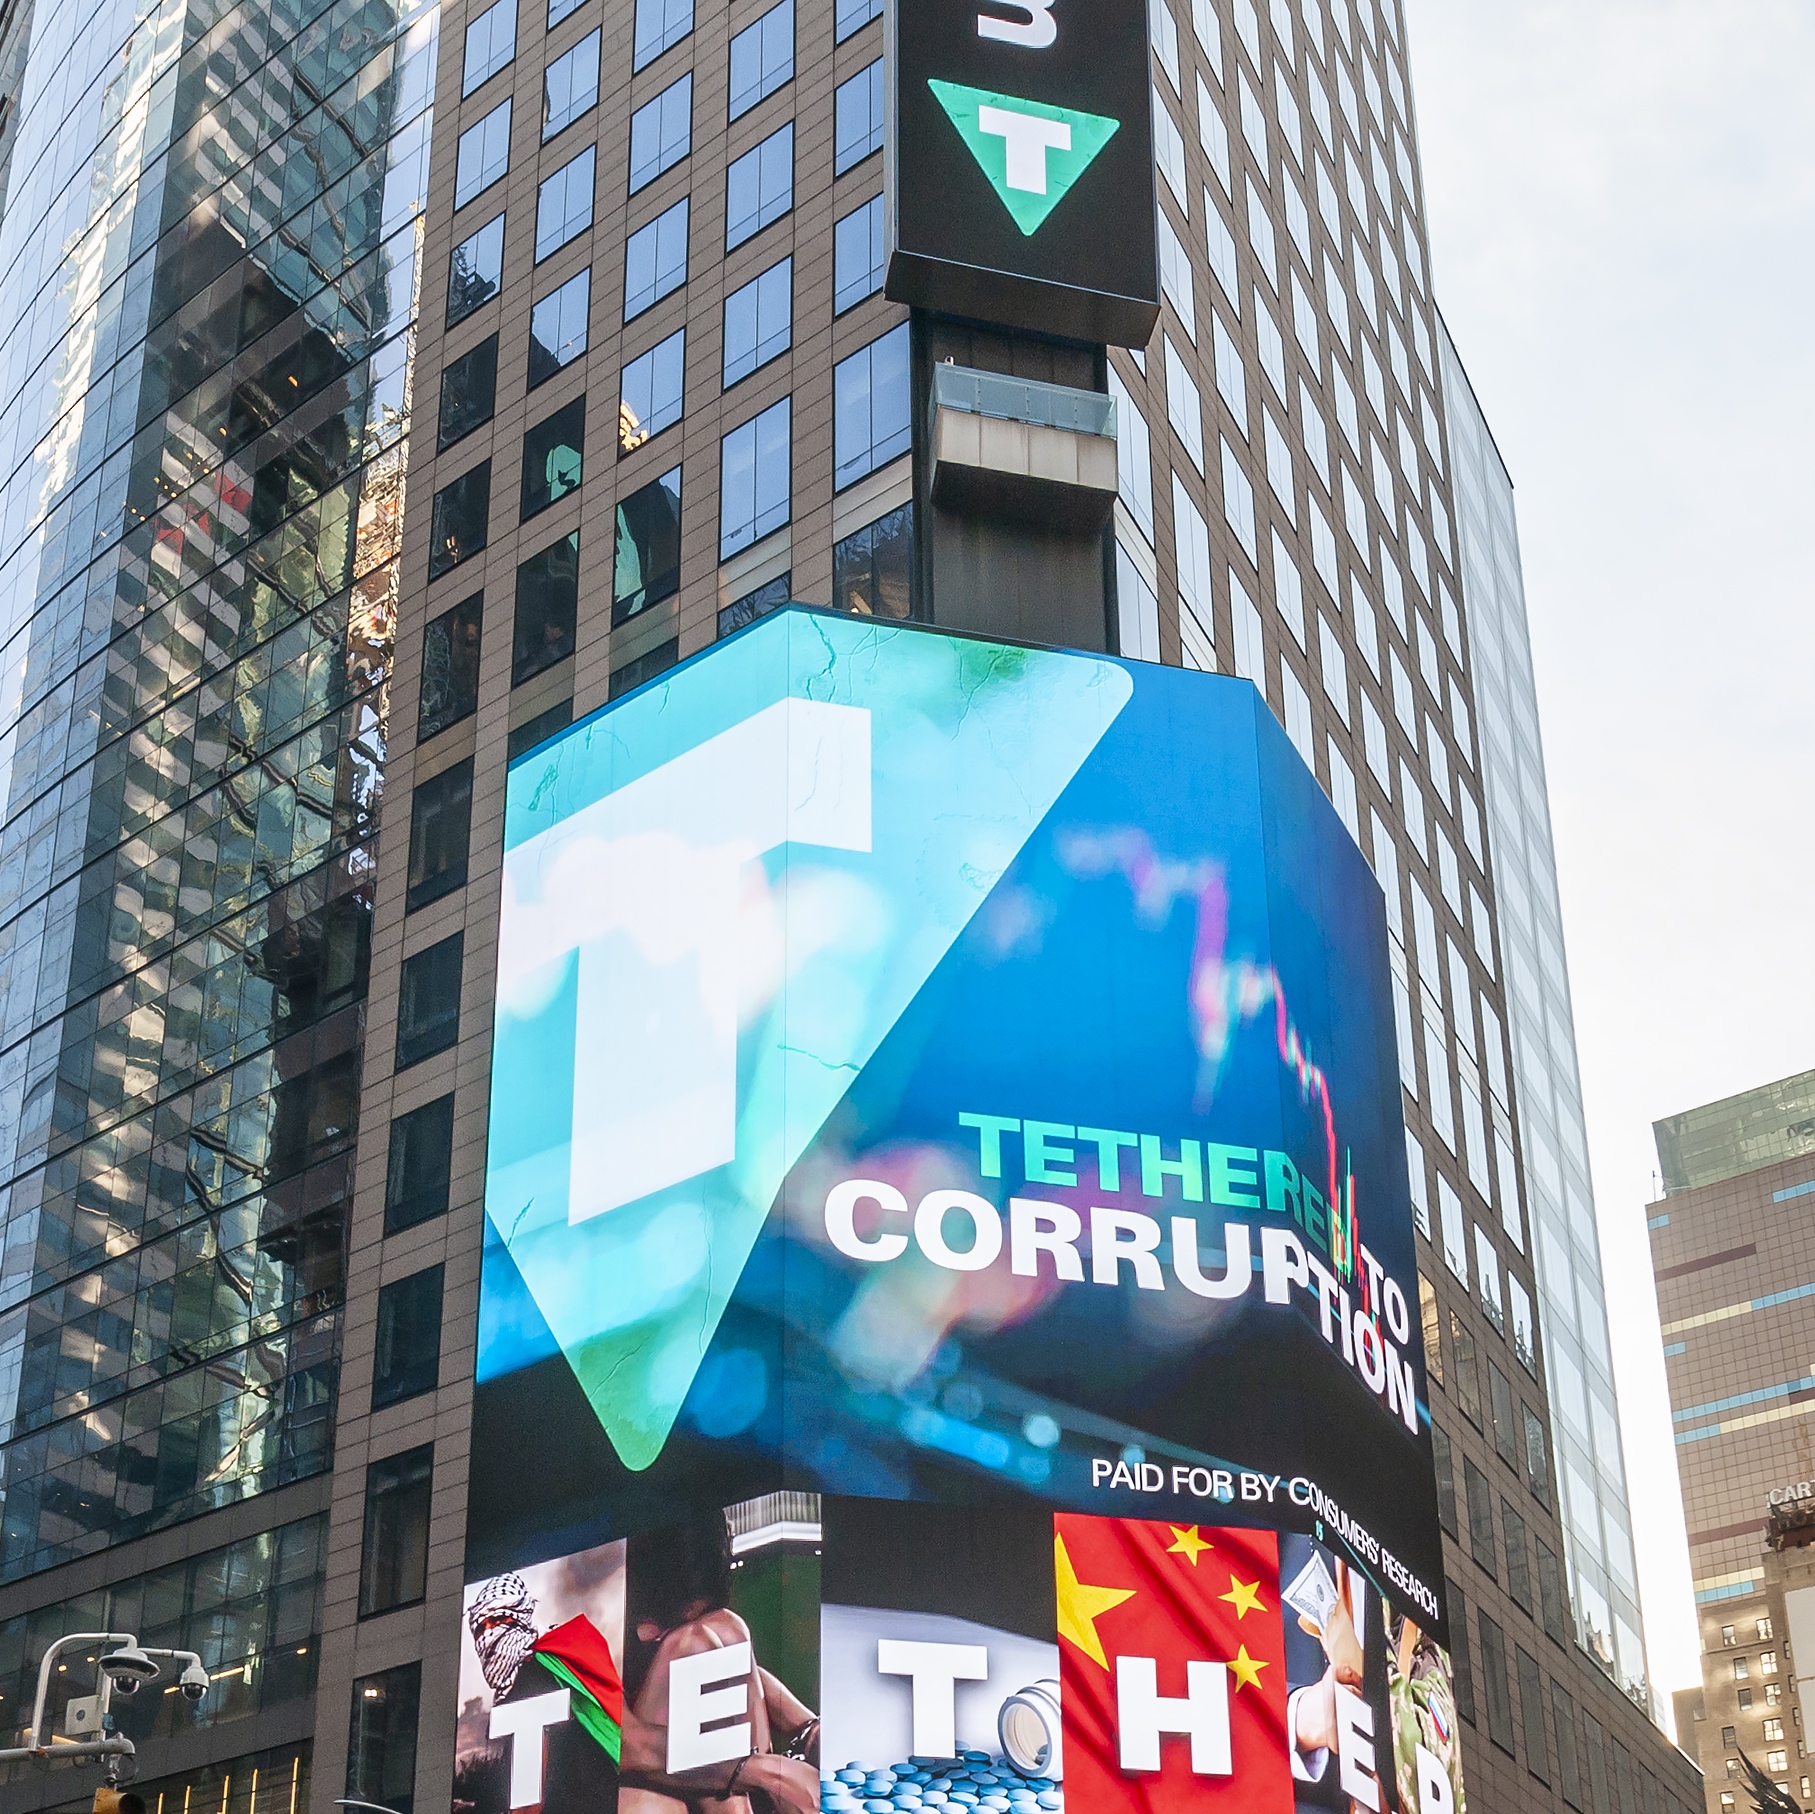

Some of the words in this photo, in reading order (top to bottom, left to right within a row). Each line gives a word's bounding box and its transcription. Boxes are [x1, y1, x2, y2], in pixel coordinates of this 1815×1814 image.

[823, 1178, 1418, 1436] CORRUPTION
[958, 1112, 1354, 1274] TETHERED
[1362, 1243, 1409, 1346] TO
[1092, 1458, 1164, 1494] PAID
[1172, 1464, 1235, 1500] FOR
[1240, 1471, 1281, 1503] BY
[1288, 1476, 1380, 1565] CONSUMERS'
[1381, 1547, 1439, 1621] RESEARCH
